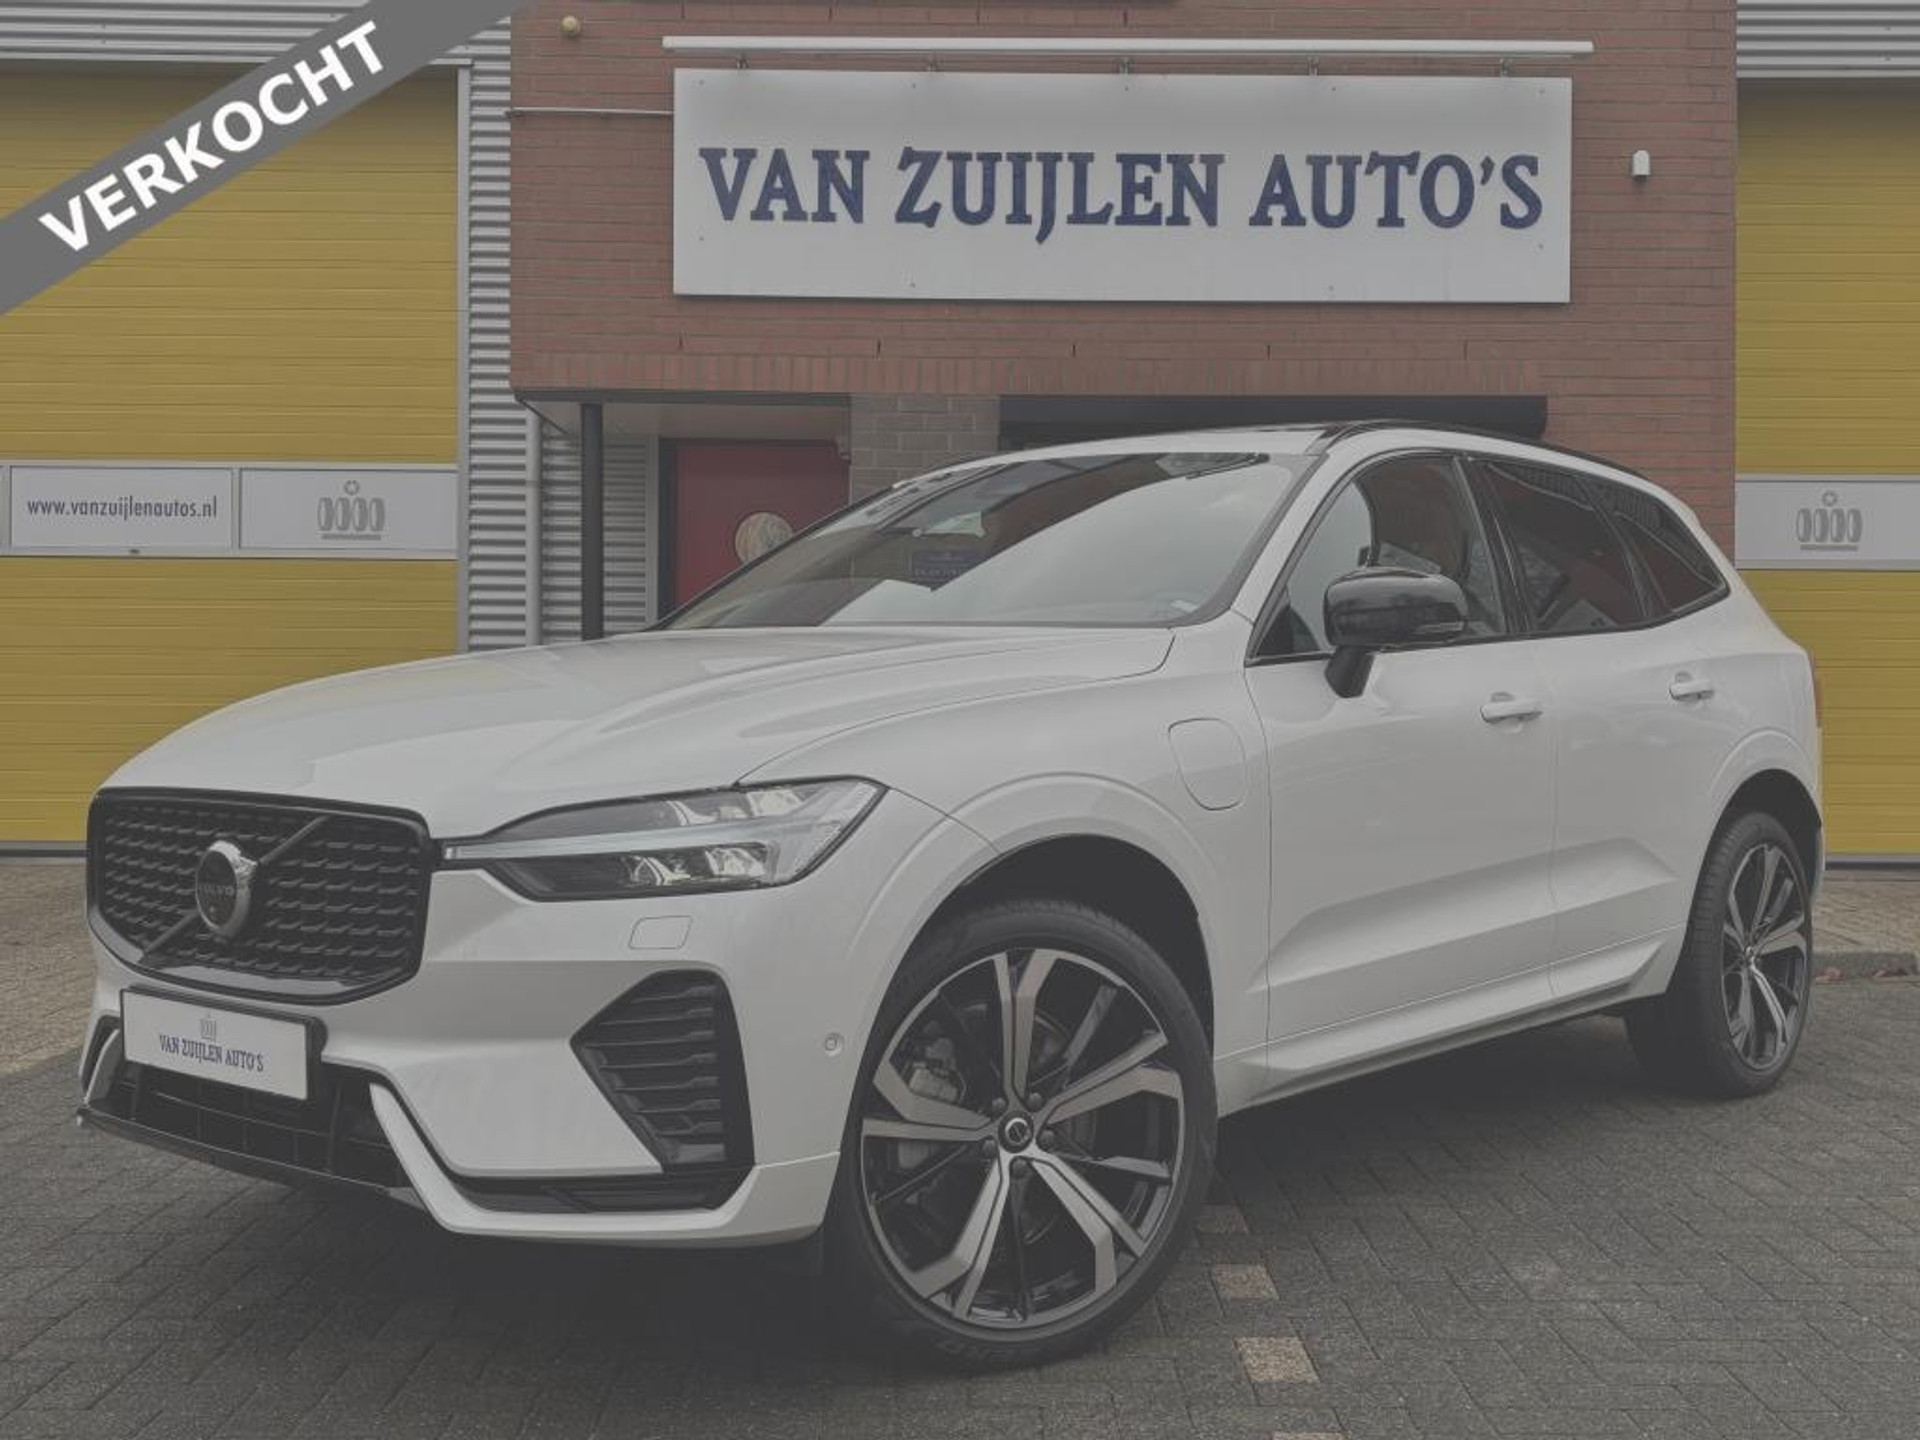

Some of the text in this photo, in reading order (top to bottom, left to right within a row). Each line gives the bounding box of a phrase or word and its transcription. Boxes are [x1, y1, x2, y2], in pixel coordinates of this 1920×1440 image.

[700, 146, 1542, 244] VAN ZUIJLEN AUTO'S
[27, 495, 217, 521] www.vanzuijlenautos.nl
[159, 1034, 264, 1072] VAN ZUIJLEN AUTO'S
